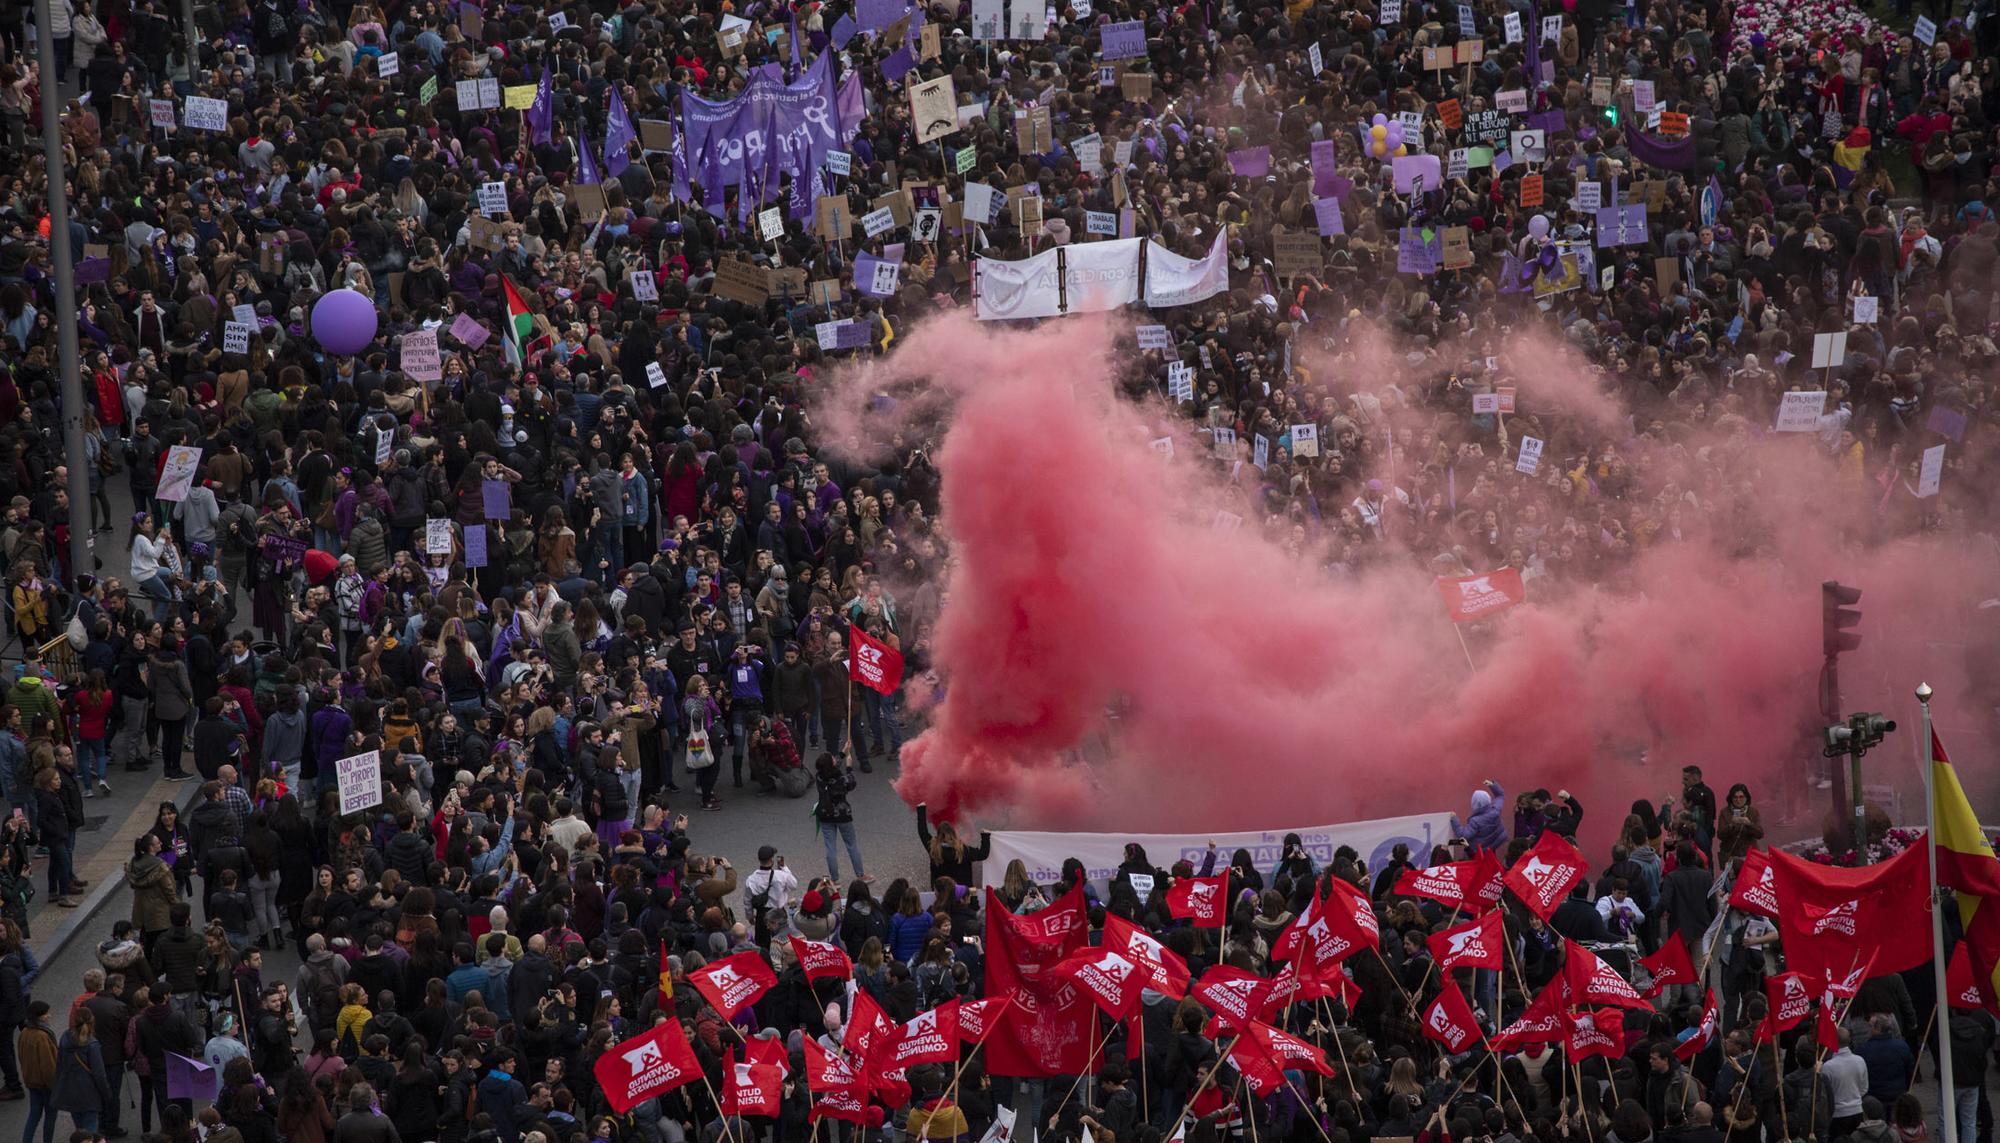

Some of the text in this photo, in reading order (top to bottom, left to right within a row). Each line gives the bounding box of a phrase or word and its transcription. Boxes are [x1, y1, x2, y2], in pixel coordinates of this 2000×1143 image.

[1464, 116, 1510, 133] NI MERCADO
[1468, 112, 1480, 123] NO
[1482, 110, 1498, 121] SOY
[1466, 132, 1478, 143] NI
[832, 154, 850, 163] LOCAS
[226, 325, 247, 333] AMA
[339, 753, 375, 774] NO QUIERO
[340, 766, 376, 786] TU PIROPO
[344, 780, 376, 796] QUIERO TU
[344, 790, 378, 812] RESPETO
[1484, 882, 1504, 895] JUVEN
[1537, 863, 1566, 900] JUVENTUD
[1542, 866, 1577, 907] COMUNISTA
[1742, 891, 1779, 914] COMUN
[1749, 886, 1778, 906] JUVEN
[721, 977, 754, 1002] JUVENTUD
[724, 983, 761, 1009] COMUNISTA
[1780, 995, 1810, 1012] JUVEN
[738, 1087, 762, 1098] NTUD
[738, 1095, 766, 1106] NISTA
